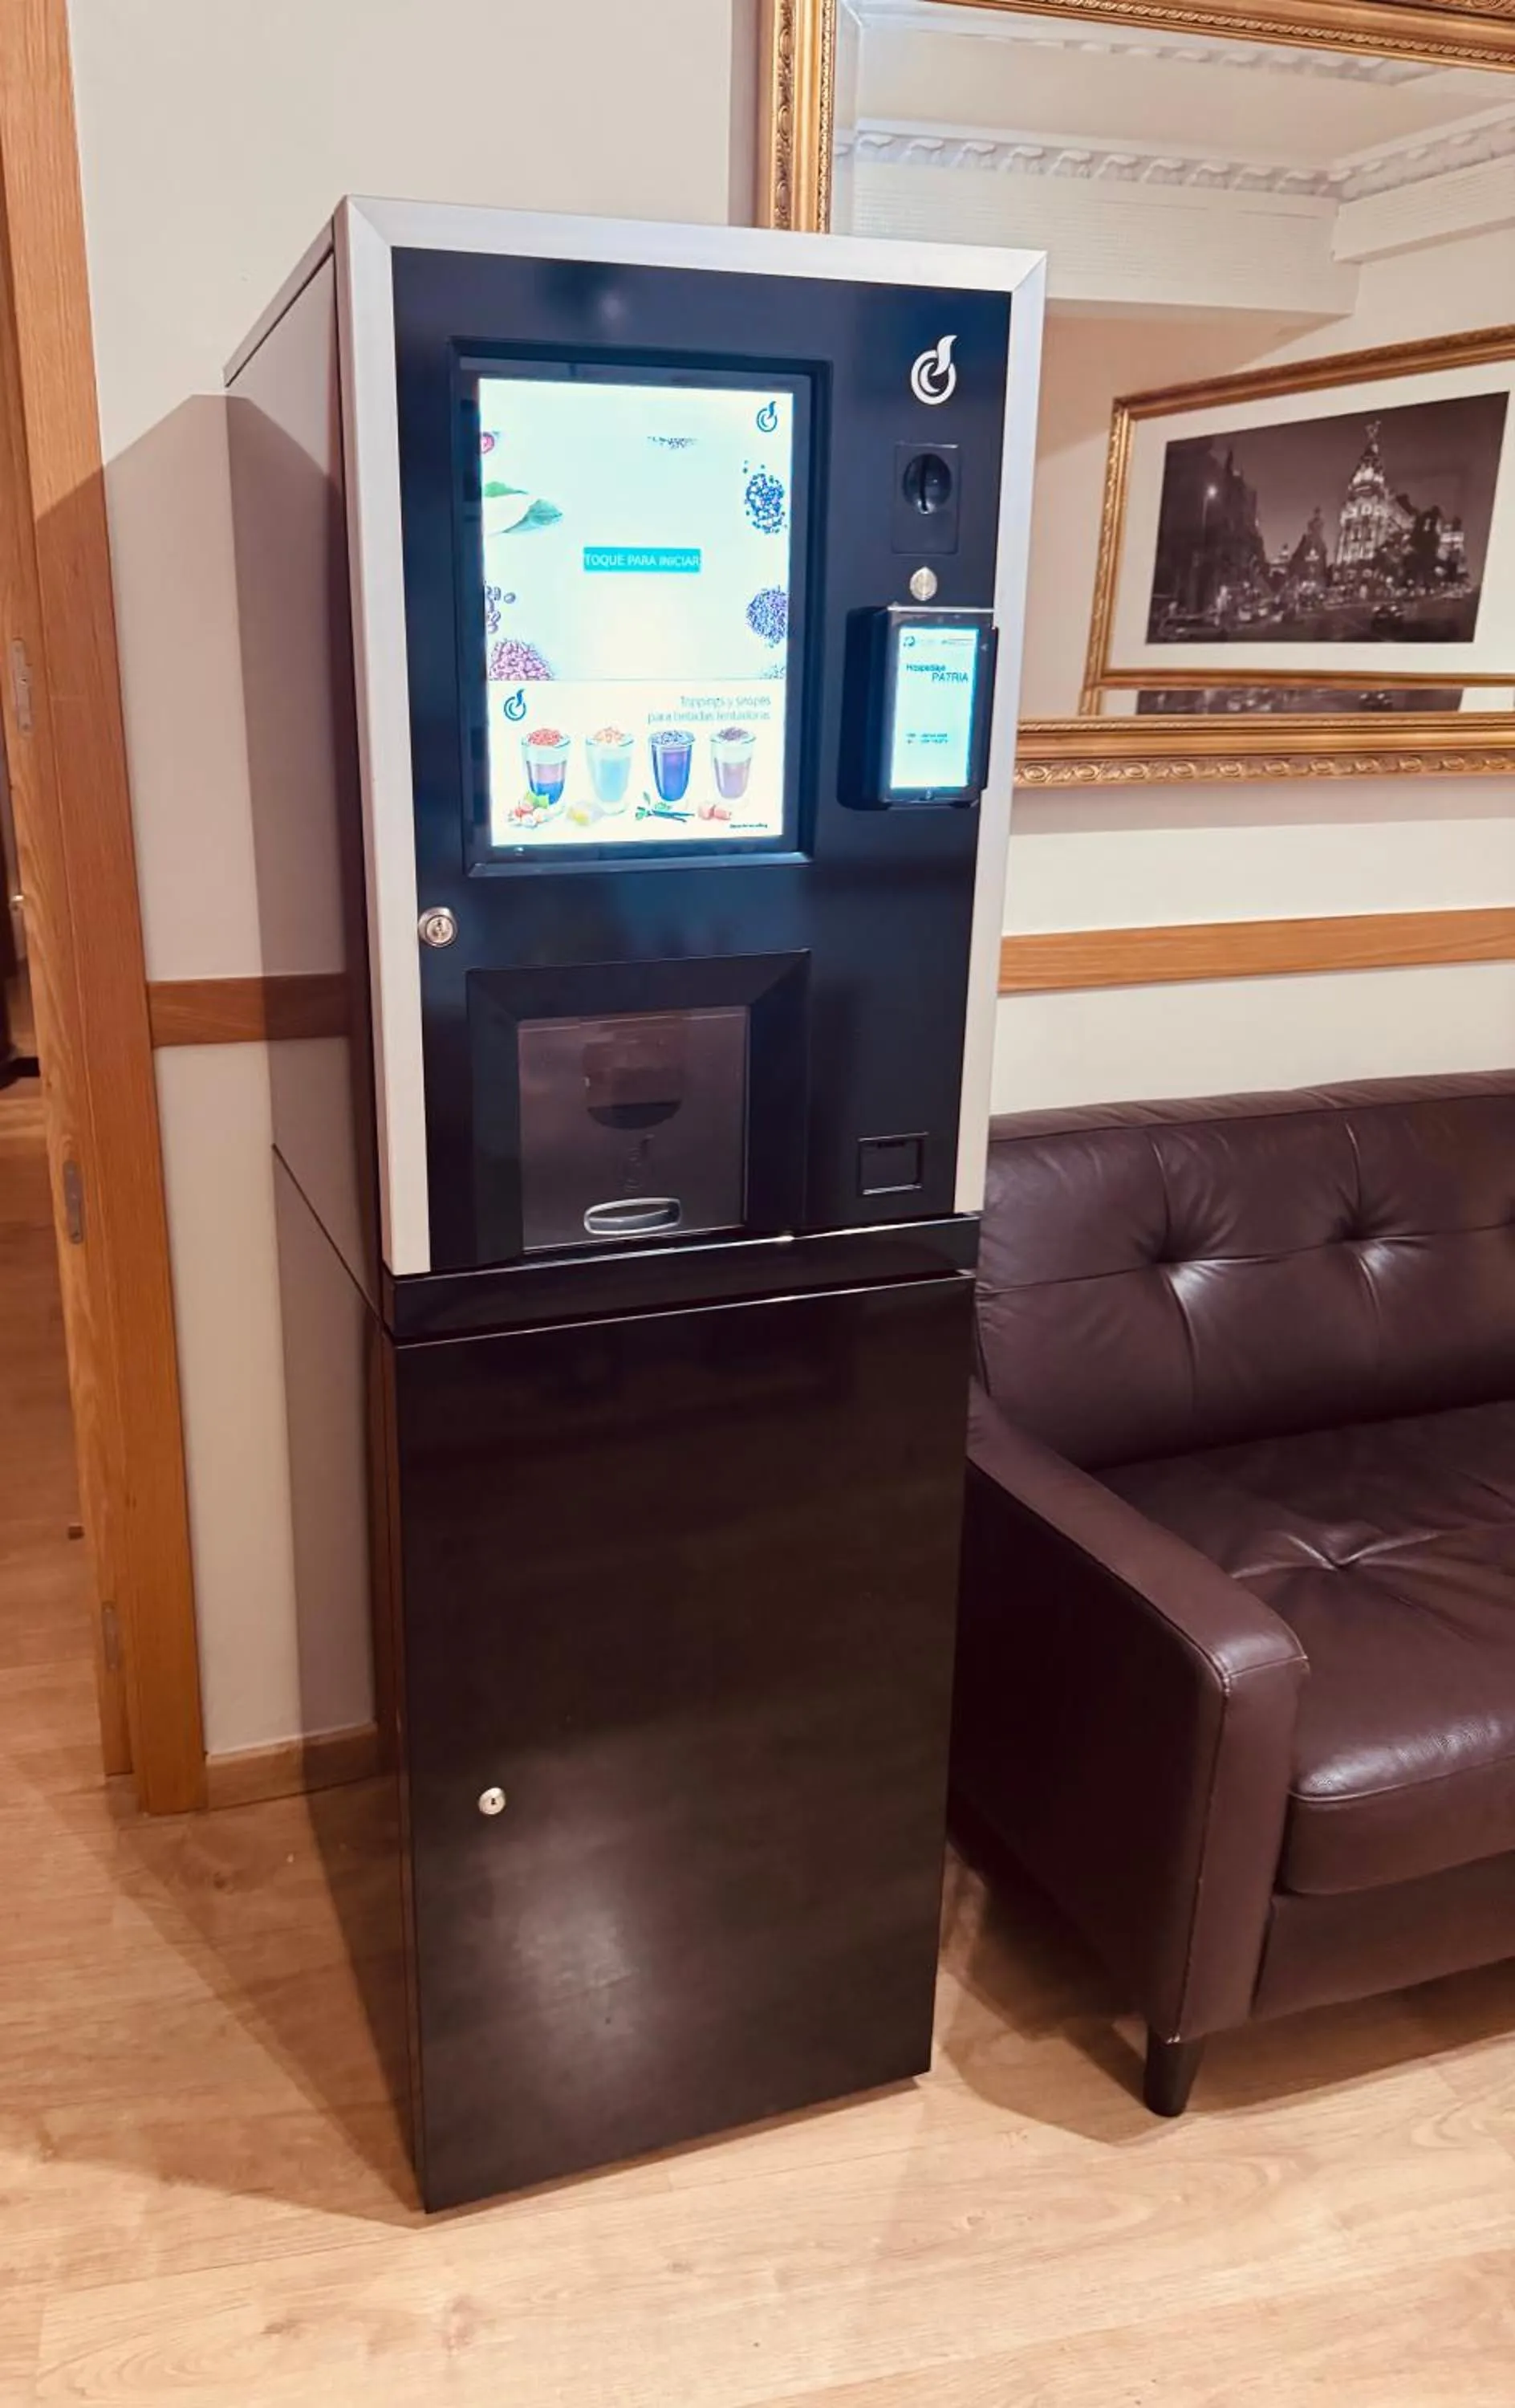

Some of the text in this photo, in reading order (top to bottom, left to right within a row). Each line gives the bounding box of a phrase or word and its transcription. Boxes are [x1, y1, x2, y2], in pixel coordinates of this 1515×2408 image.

[585, 552, 625, 567] TOQUE
[627, 554, 657, 567] PARA
[932, 672, 969, 681] PATRIA
[648, 712, 672, 725] para
